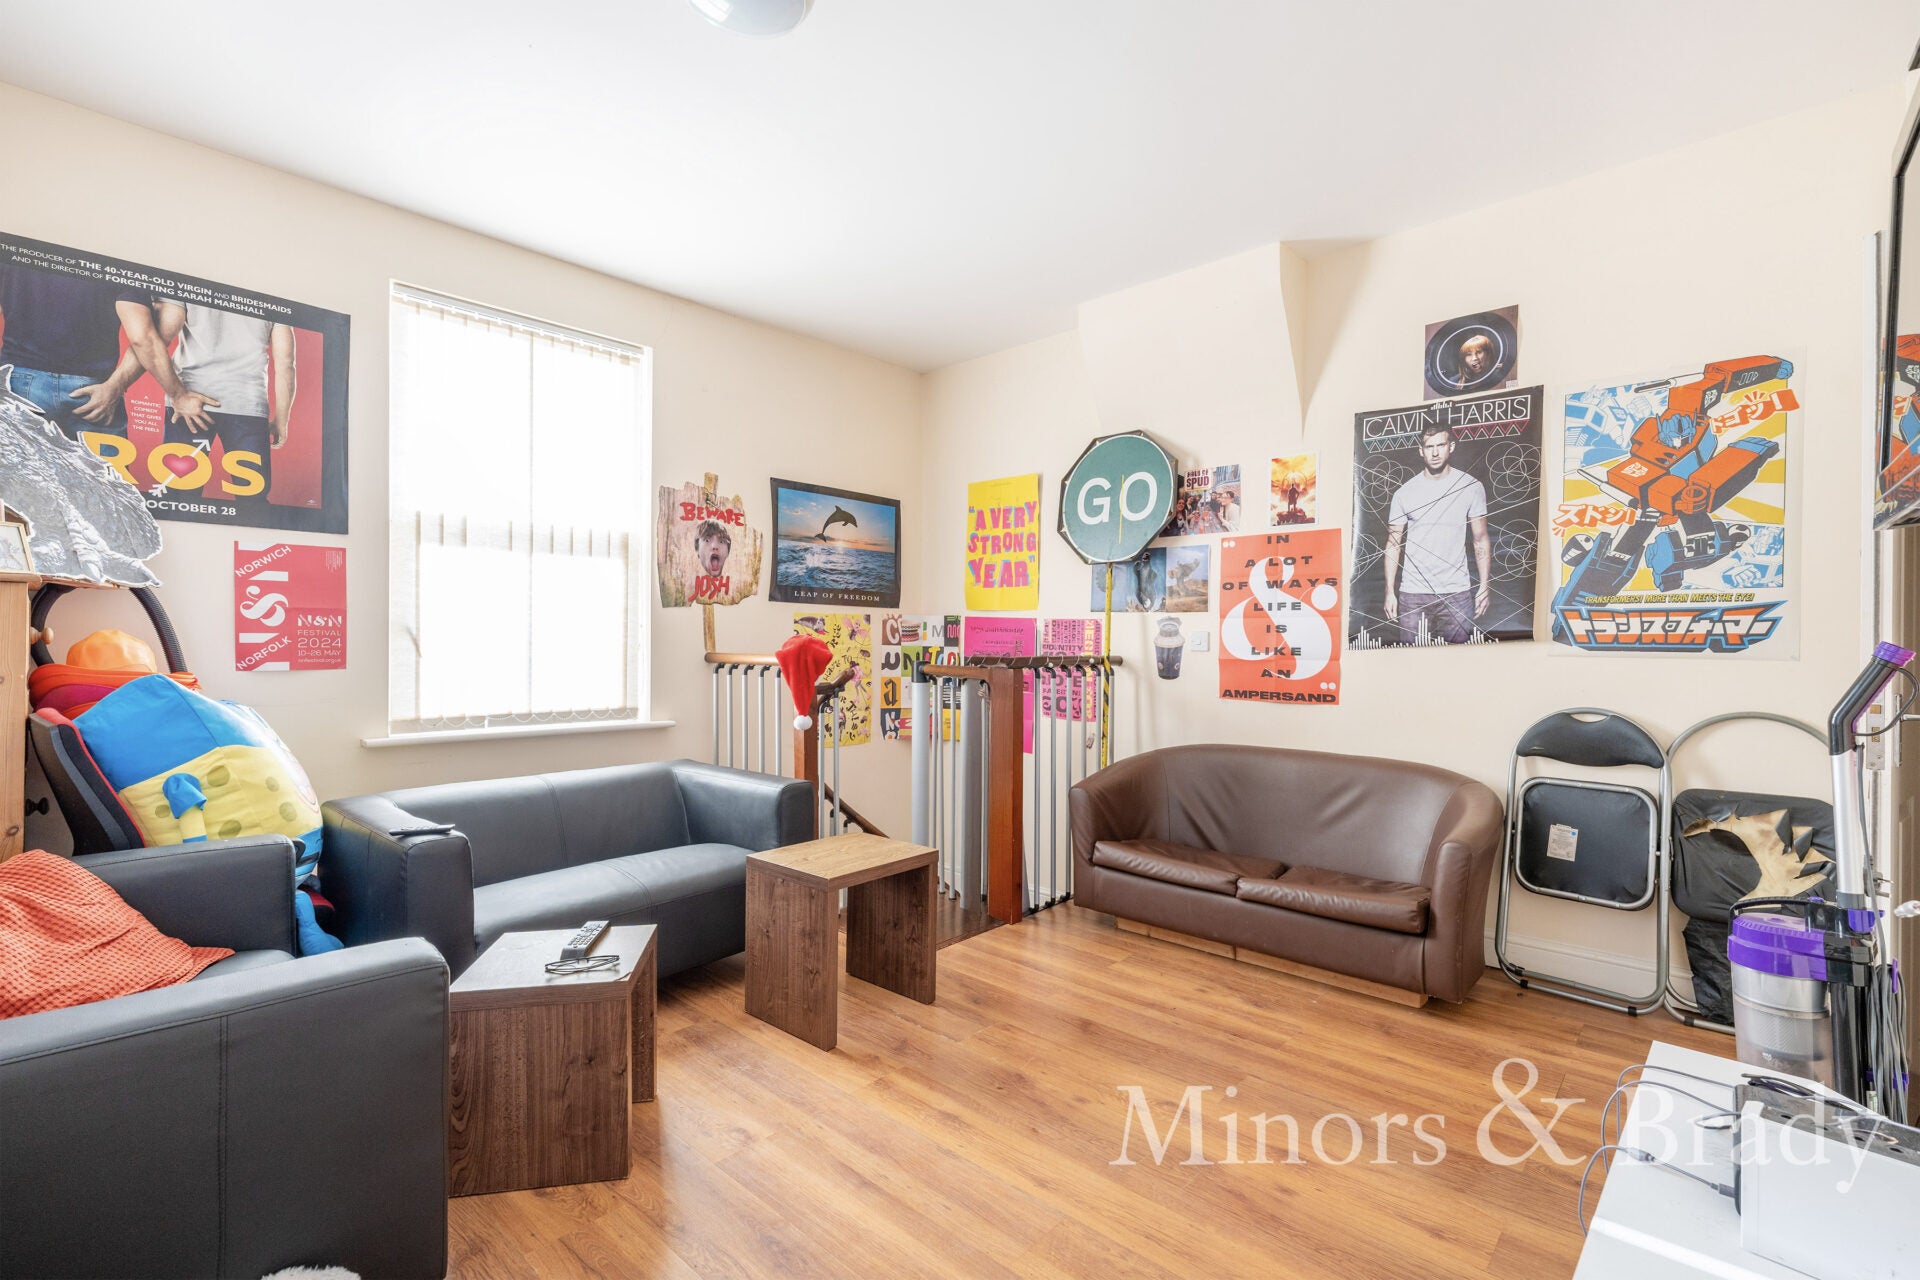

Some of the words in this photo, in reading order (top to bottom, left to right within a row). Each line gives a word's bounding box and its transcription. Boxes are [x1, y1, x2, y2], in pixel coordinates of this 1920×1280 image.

[0, 243, 17, 253] THE
[19, 247, 63, 263] PRODUCER
[79, 259, 101, 271] THE
[104, 266, 174, 288] 40-YEAR-OLD
[177, 282, 212, 296] VIRGIN
[213, 291, 230, 300] AND
[231, 294, 292, 315] BRIDESMAIDS
[11, 255, 31, 264] AND
[34, 259, 49, 268] THE
[51, 263, 91, 277] DIRECTOR
[105, 274, 175, 295] FORGETTING
[177, 290, 212, 304] SARAH
[214, 298, 265, 316] MARSHALL
[131, 399, 161, 408] ROMANTIC
[1366, 409, 1439, 438] CALVIN
[1448, 397, 1526, 425] HARRIS
[1186, 476, 1210, 490] SPUD
[1077, 471, 1158, 525] GO
[146, 500, 217, 515] OCTOBER
[222, 506, 237, 516] 28
[680, 502, 745, 526] BEWARE
[989, 501, 1037, 530] VERY
[968, 532, 1037, 555] STRONG
[1267, 535, 1289, 544] IN
[235, 545, 292, 577] NORWICH
[1245, 559, 1256, 569] A
[1268, 556, 1313, 567] LOT
[688, 575, 730, 601] JOSH
[1222, 581, 1249, 591] OF
[1266, 577, 1338, 589] WAYS
[794, 590, 818, 598] LEAP
[838, 593, 881, 602] FREEDOM
[1644, 594, 1666, 603] MORE
[1668, 594, 1689, 602] THAN
[1690, 593, 1717, 602] MEETS
[1718, 593, 1734, 602] THE
[1253, 602, 1302, 612] LIFE
[1266, 624, 1288, 634] IS
[297, 637, 342, 648] 2024
[237, 635, 292, 670] NORFOLK
[1251, 646, 1302, 657] LIKE
[1260, 668, 1291, 679] AN
[1222, 689, 1337, 704] AMPERSAND
